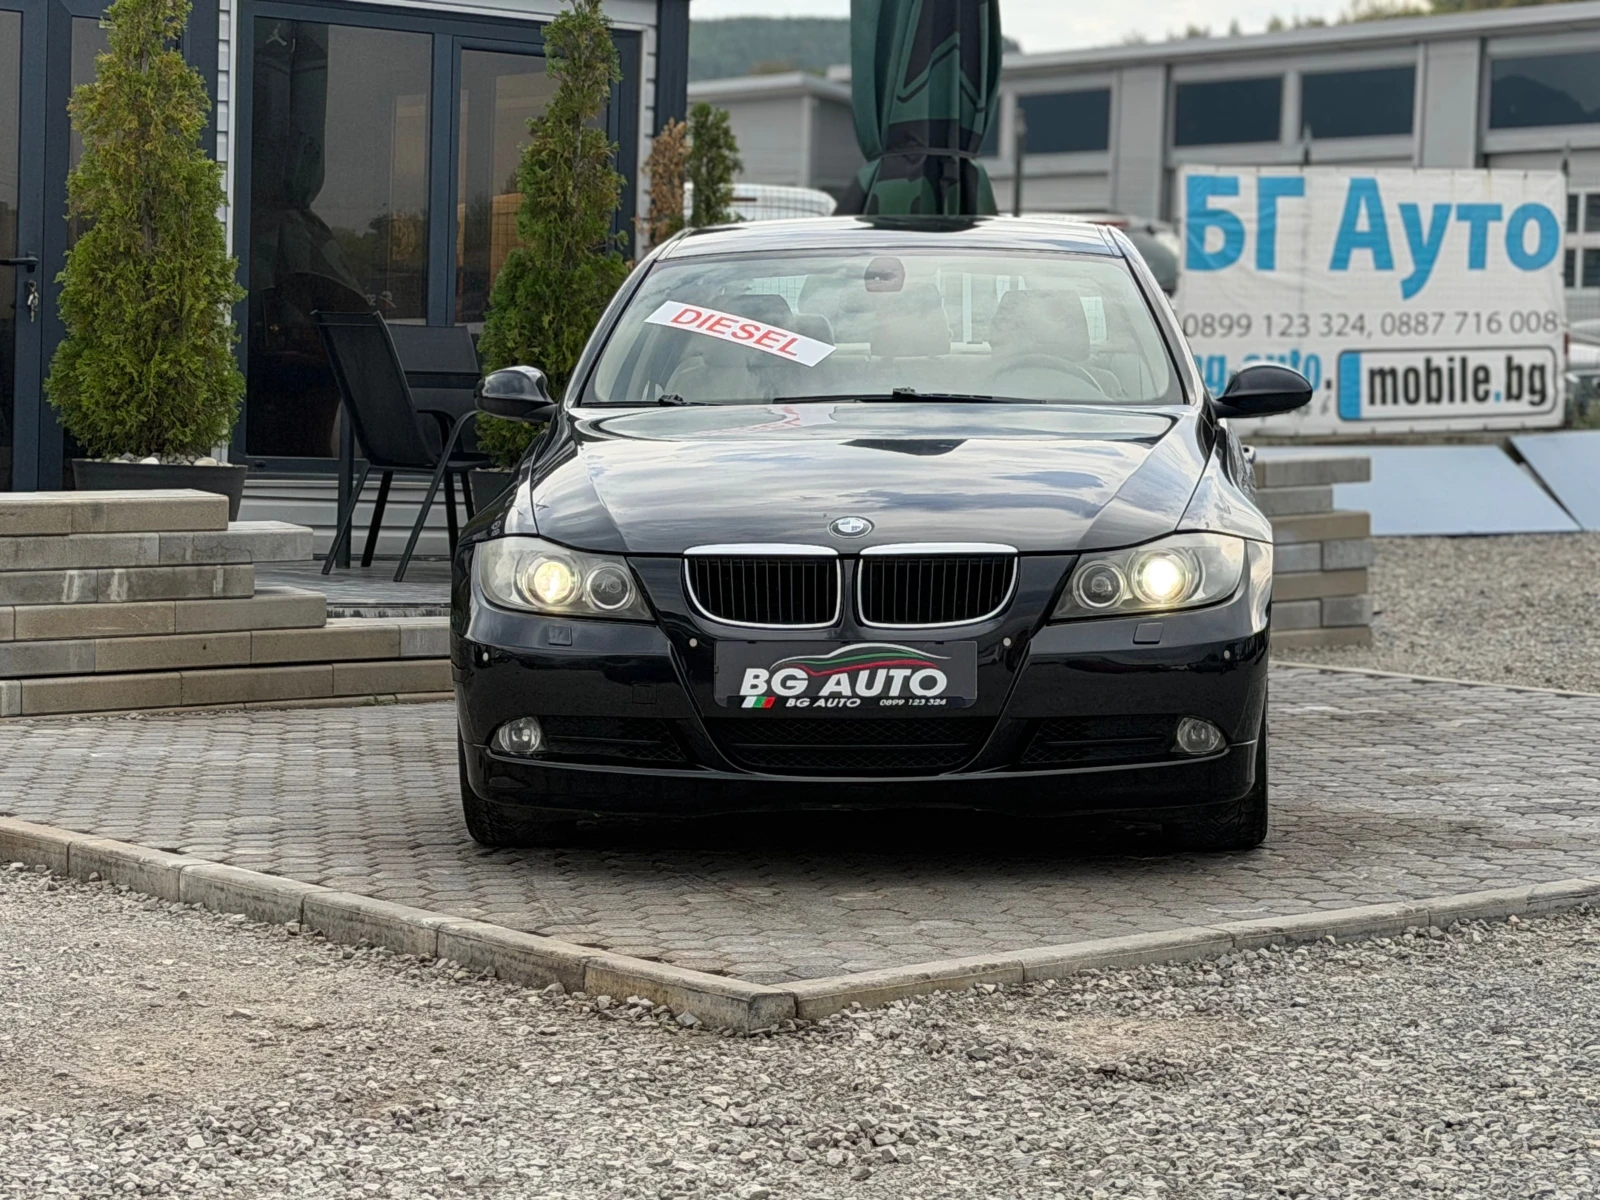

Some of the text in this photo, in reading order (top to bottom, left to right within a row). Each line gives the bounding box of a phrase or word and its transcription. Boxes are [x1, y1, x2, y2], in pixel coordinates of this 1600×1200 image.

[1186, 175, 1560, 300] БГ Ауто
[670, 308, 799, 356] DIESEL
[1183, 310, 1558, 339] 0899 123 324, 0887 716 008
[1368, 355, 1547, 406] mobile.bg
[739, 668, 948, 697] BG AUTO
[785, 698, 947, 708] BG AUTO 0899 123 324
